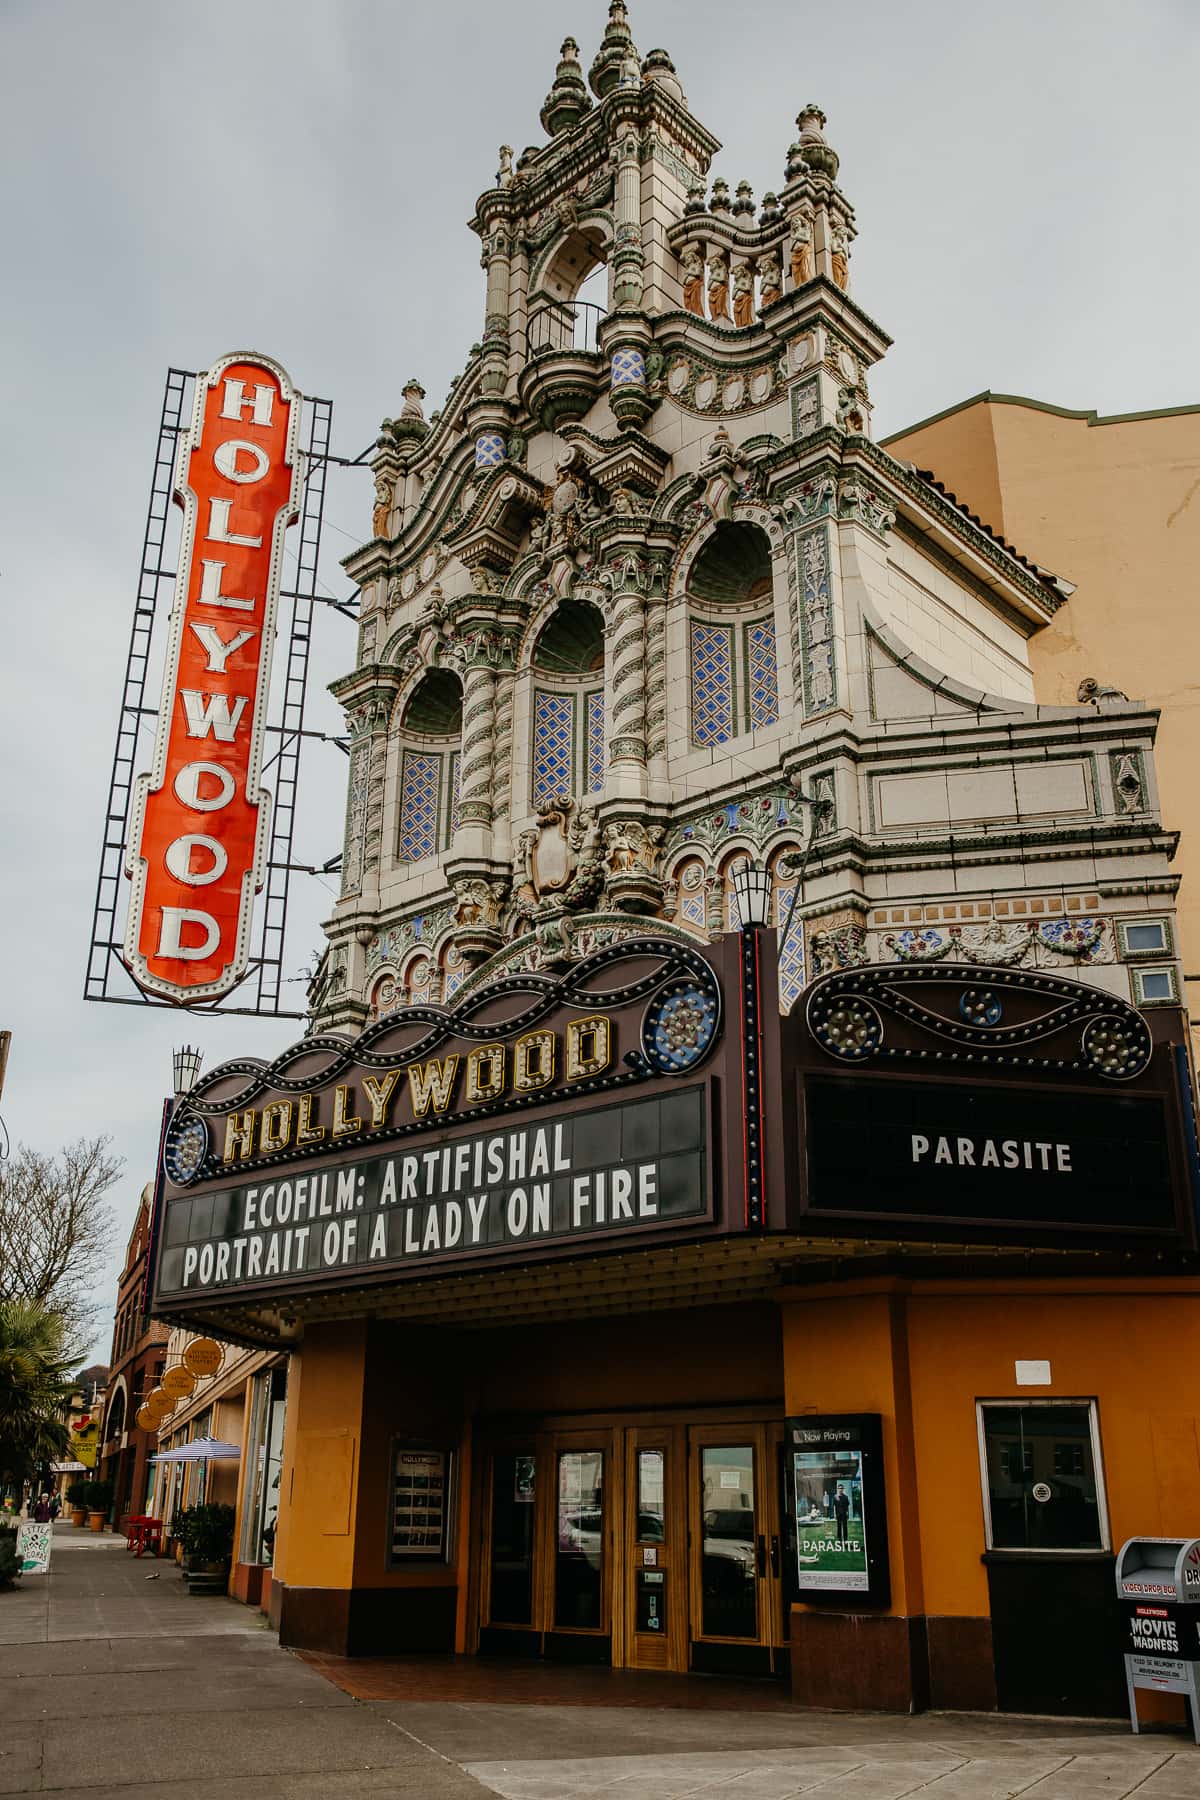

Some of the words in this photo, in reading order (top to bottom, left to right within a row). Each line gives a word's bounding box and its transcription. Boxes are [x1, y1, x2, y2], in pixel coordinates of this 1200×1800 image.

[153, 377, 275, 961] HOLLYWOOD
[223, 1014, 611, 1163] HOLLYWOOD
[911, 1134, 1073, 1172] PARASITE
[243, 1168, 366, 1230] ECOFILM:
[380, 1123, 571, 1205] ARTIFISHAL
[183, 1227, 310, 1287] PORTRAIT
[323, 1219, 357, 1266] OF
[370, 1213, 386, 1258] A
[405, 1195, 488, 1253] LADY
[507, 1183, 550, 1237] ON
[573, 1163, 657, 1227] FIRE
[803, 1431, 821, 1441] Now
[823, 1431, 850, 1441] Playing
[803, 1540, 861, 1553] PARASITE
[1123, 1583, 1141, 1593] VIDEO
[1143, 1584, 1162, 1595] DROP
[1163, 1585, 1176, 1597] BOX
[1136, 1608, 1168, 1616] HOLLYWOOD
[1130, 1617, 1177, 1639] MOVIE
[1132, 1635, 1179, 1653] MADNESS
